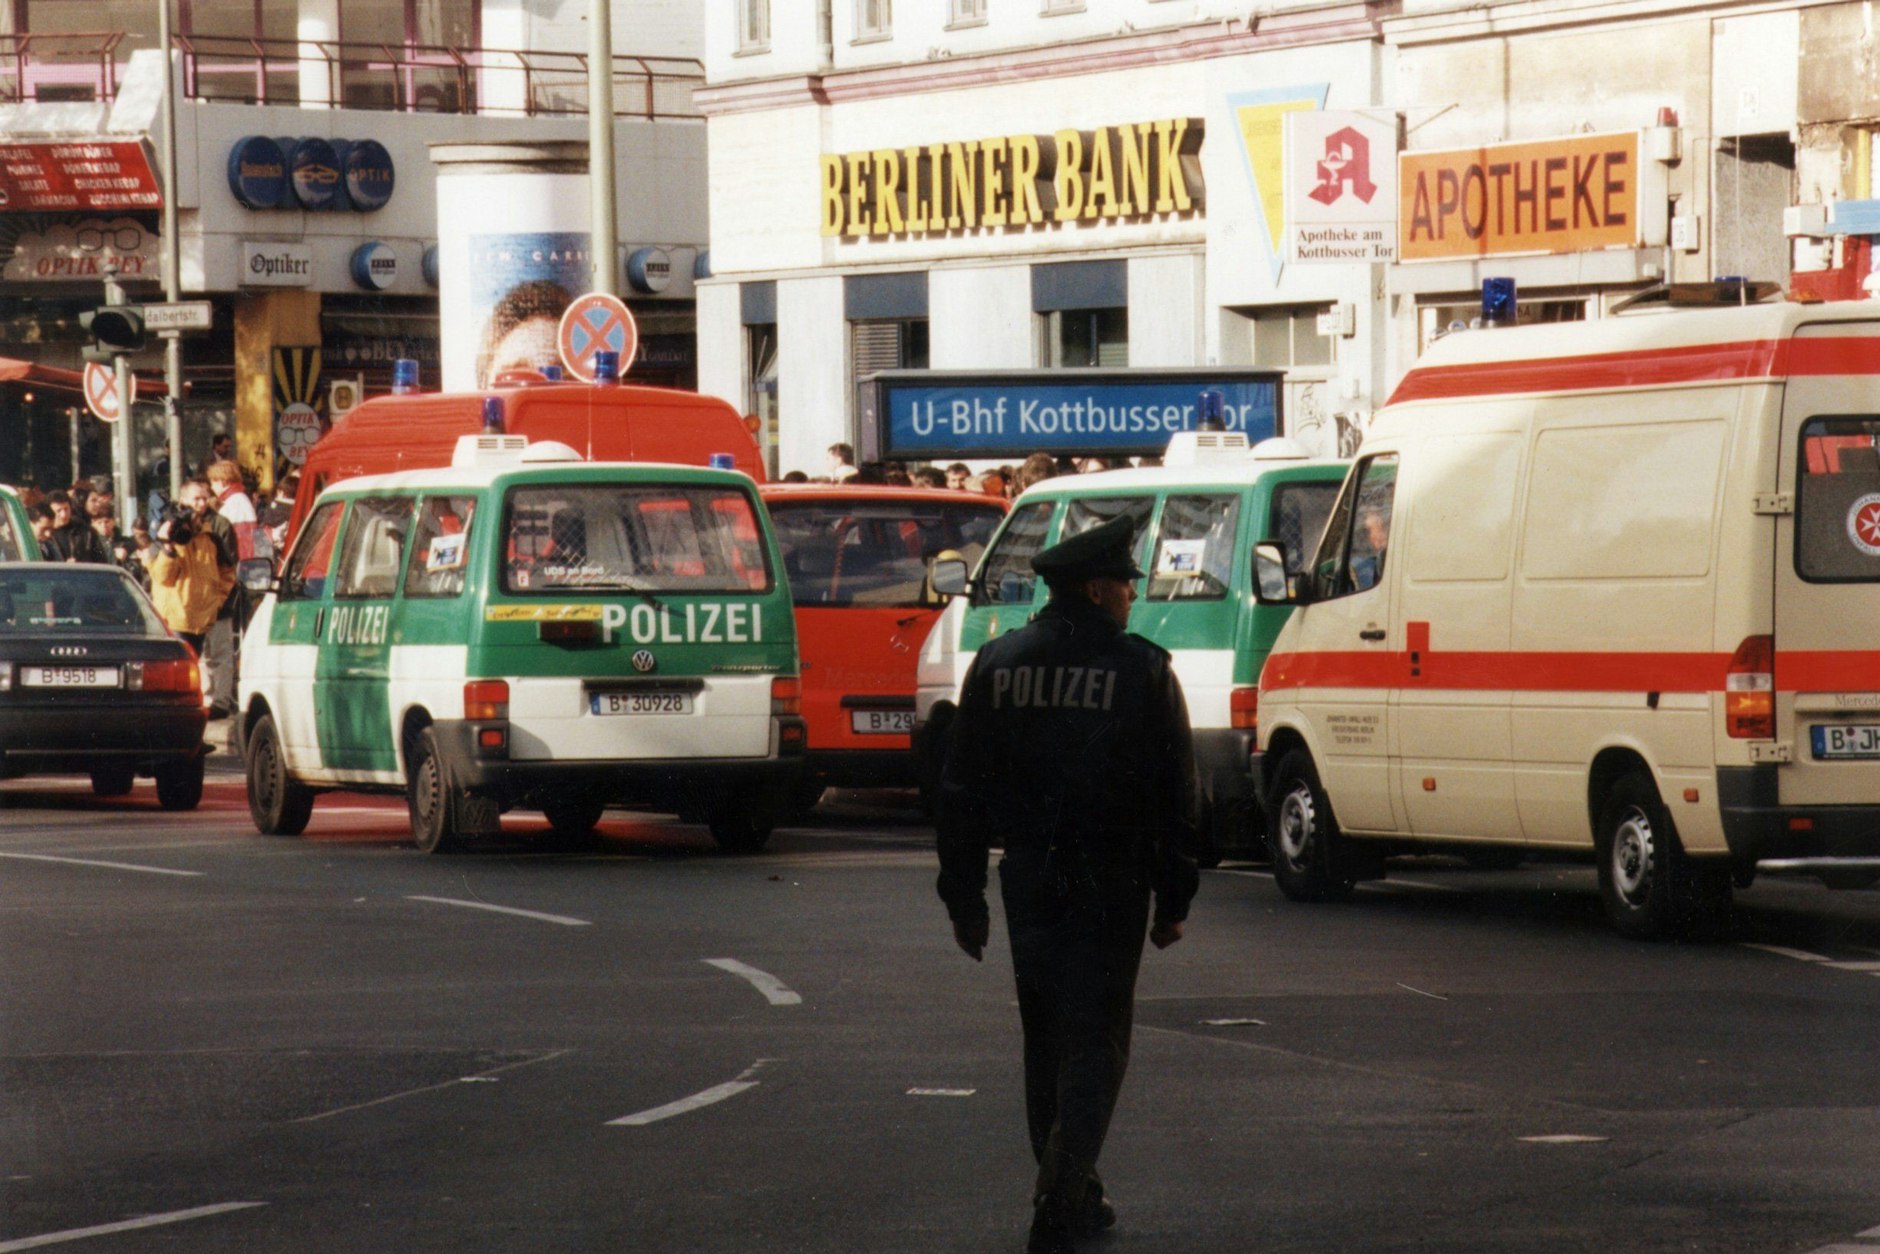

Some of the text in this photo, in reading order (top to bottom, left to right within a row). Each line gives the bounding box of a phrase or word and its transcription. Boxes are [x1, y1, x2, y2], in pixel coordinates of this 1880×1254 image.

[351, 168, 390, 181] OPTIK
[820, 117, 1192, 238] BERLINER BANK
[1408, 150, 1627, 243] APOTHEKE
[1297, 229, 1382, 244] Apotheke am
[1298, 244, 1393, 259] Kottbusser Tor
[37, 257, 101, 276] OPTIK
[250, 253, 310, 277] Optiker
[147, 309, 199, 322] dalbertstr.
[282, 412, 315, 425] OPTIK
[911, 397, 1252, 436] U-Bhf Kottbusser or
[327, 606, 389, 645] POLIZEI
[602, 602, 762, 643] POLIZEI
[42, 668, 97, 684] B 9518
[993, 666, 1118, 711] POLIZEI
[609, 695, 683, 712] B 30928
[1835, 693, 1880, 706] Merced
[870, 713, 882, 729] B
[1831, 729, 1846, 750] B
